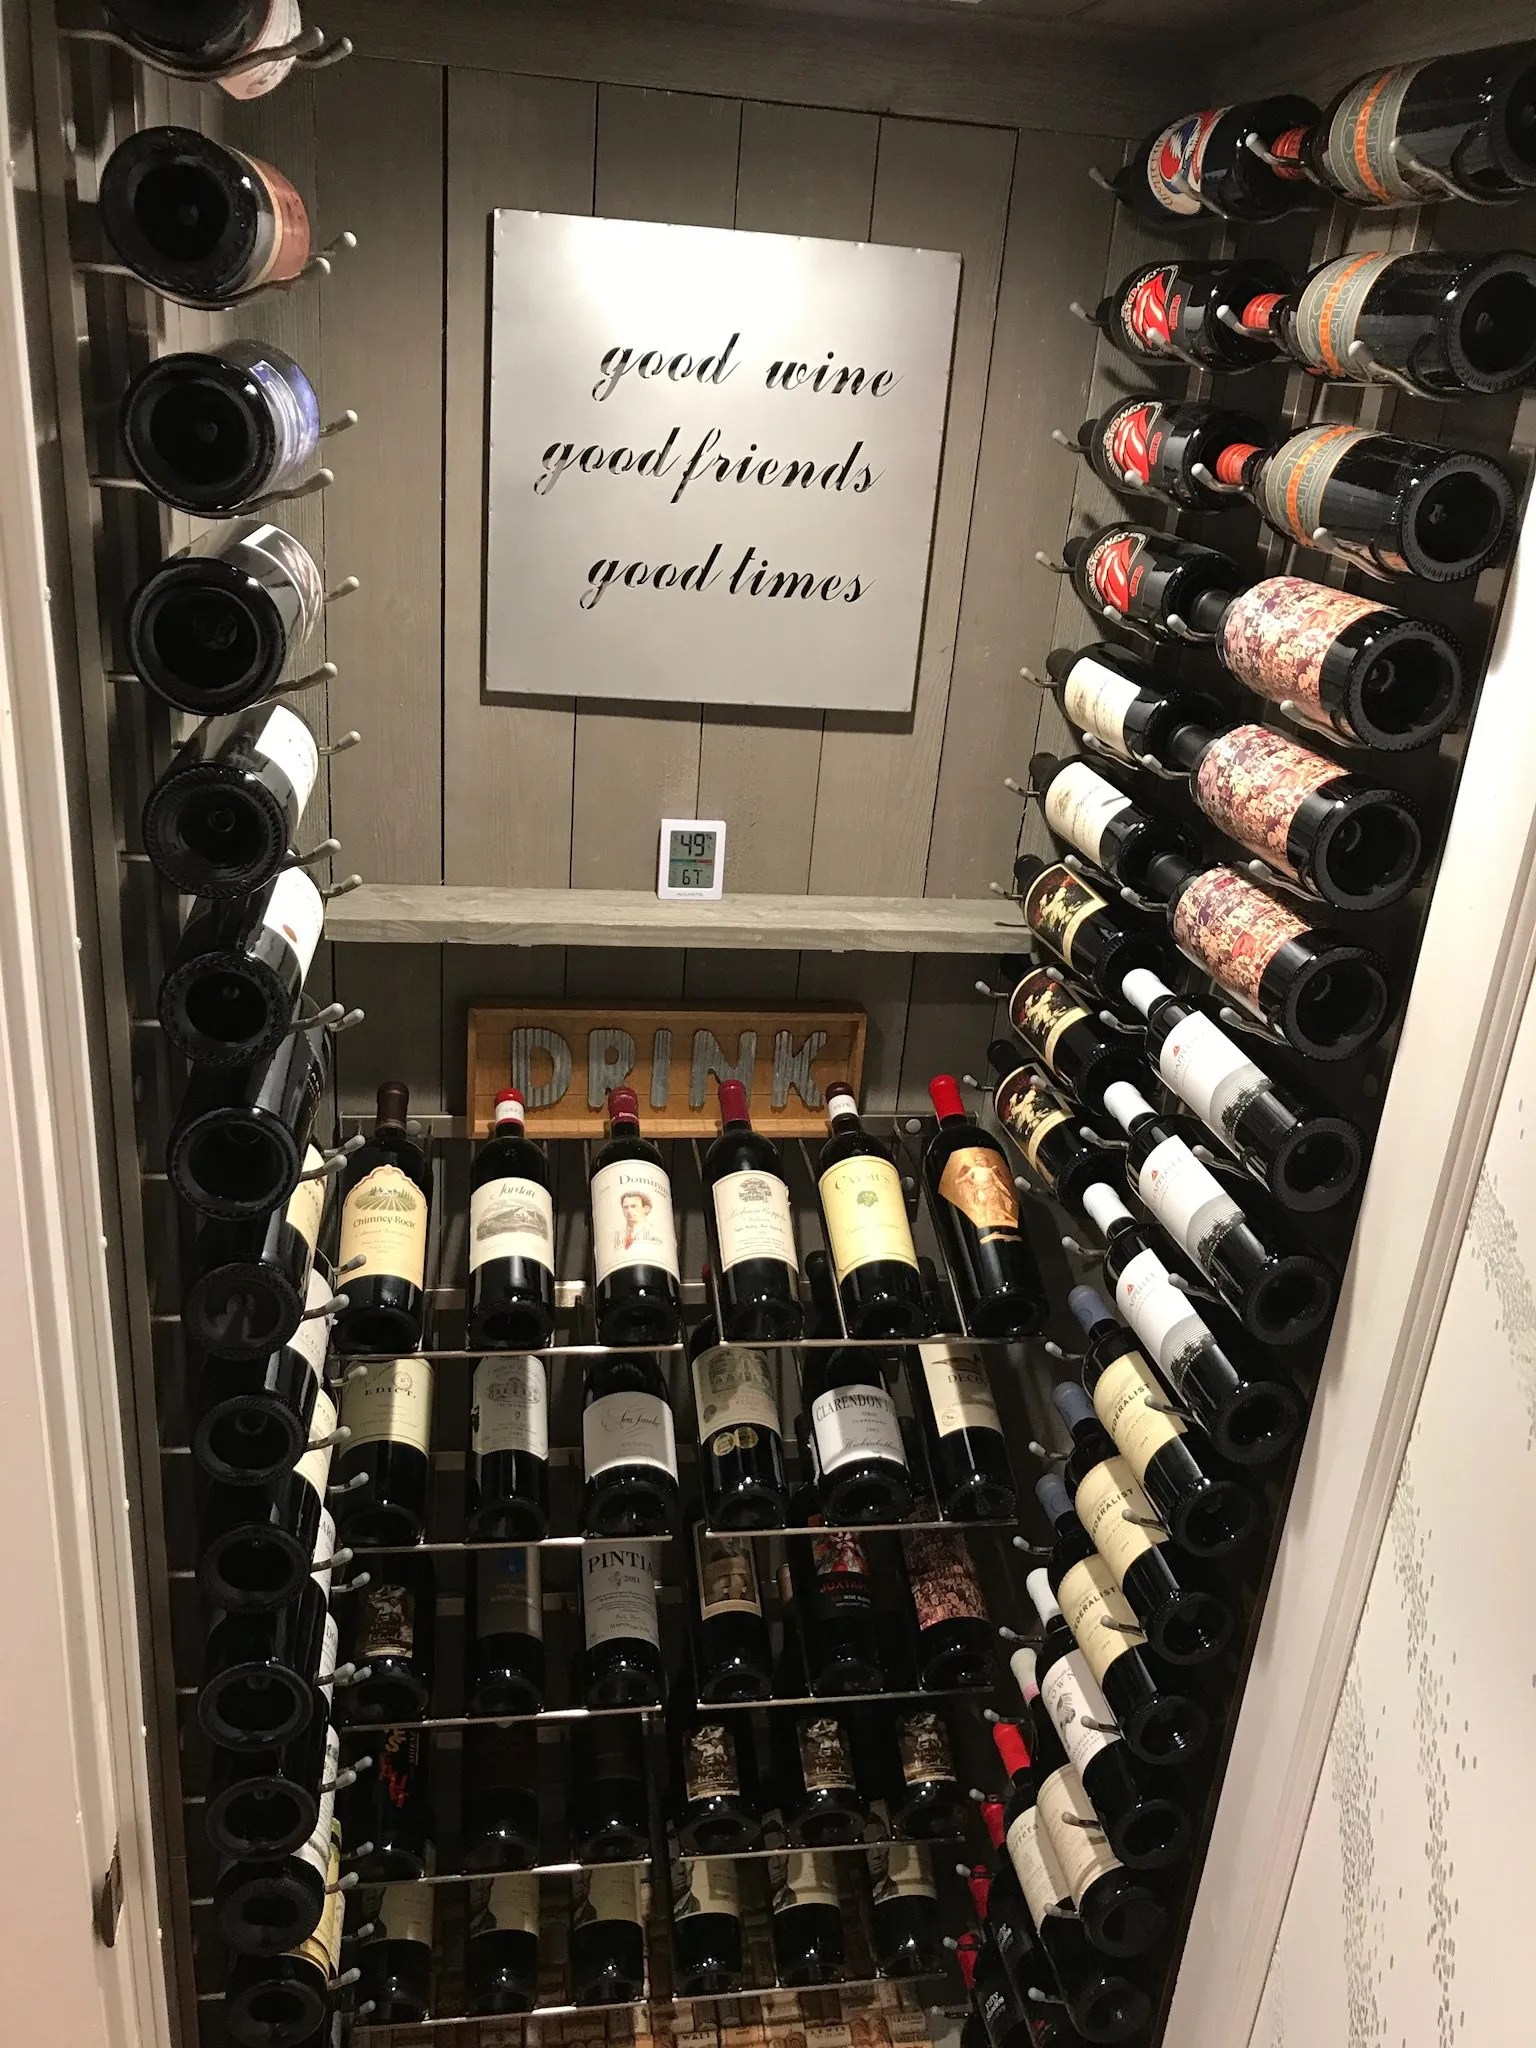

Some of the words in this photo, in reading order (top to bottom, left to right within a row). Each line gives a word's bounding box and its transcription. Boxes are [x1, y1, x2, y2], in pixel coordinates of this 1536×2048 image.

[591, 332, 742, 402] good
[765, 352, 904, 398] wine
[533, 427, 683, 496] good
[669, 427, 887, 504] friends
[580, 543, 724, 610] good
[728, 546, 877, 603] times
[680, 833, 706, 857] 49
[682, 869, 702, 886] 67
[511, 1026, 828, 1111] DRINK
[353, 1215, 393, 1228] Chimney
[394, 1215, 417, 1229] Rock
[816, 1394, 882, 1422] CLARENDON
[682, 2031, 711, 2041] WALT
